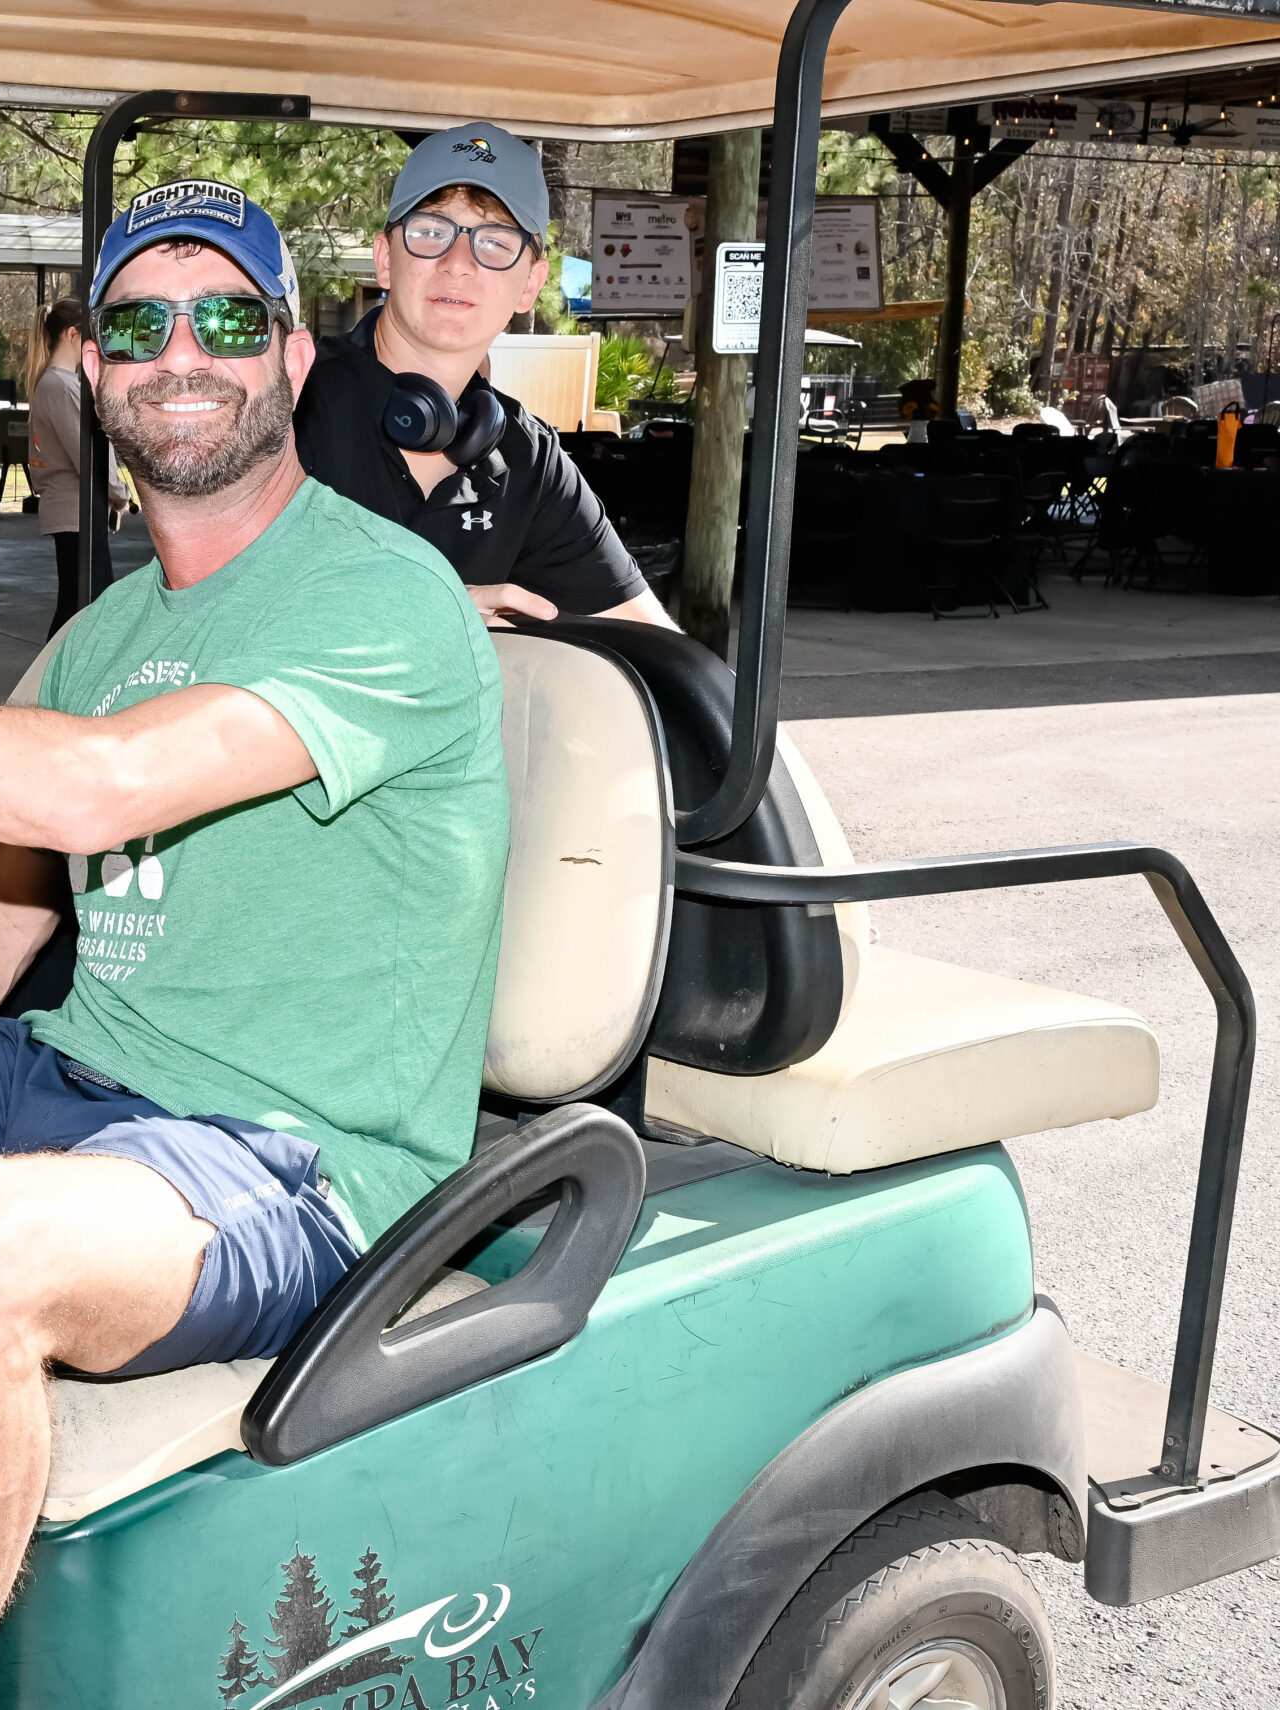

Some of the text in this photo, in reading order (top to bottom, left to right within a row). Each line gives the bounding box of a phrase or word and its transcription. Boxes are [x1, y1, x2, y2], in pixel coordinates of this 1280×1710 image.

[452, 143, 474, 152] Bay
[469, 151, 497, 164] Hill
[135, 184, 242, 210] LIGHTNING
[133, 208, 239, 230] TAMPA BAY HOCKEY
[648, 213, 676, 224] metro
[729, 252, 749, 260] SCAN
[89, 910, 166, 937] WHISKEY
[445, 1626, 544, 1704] BAY
